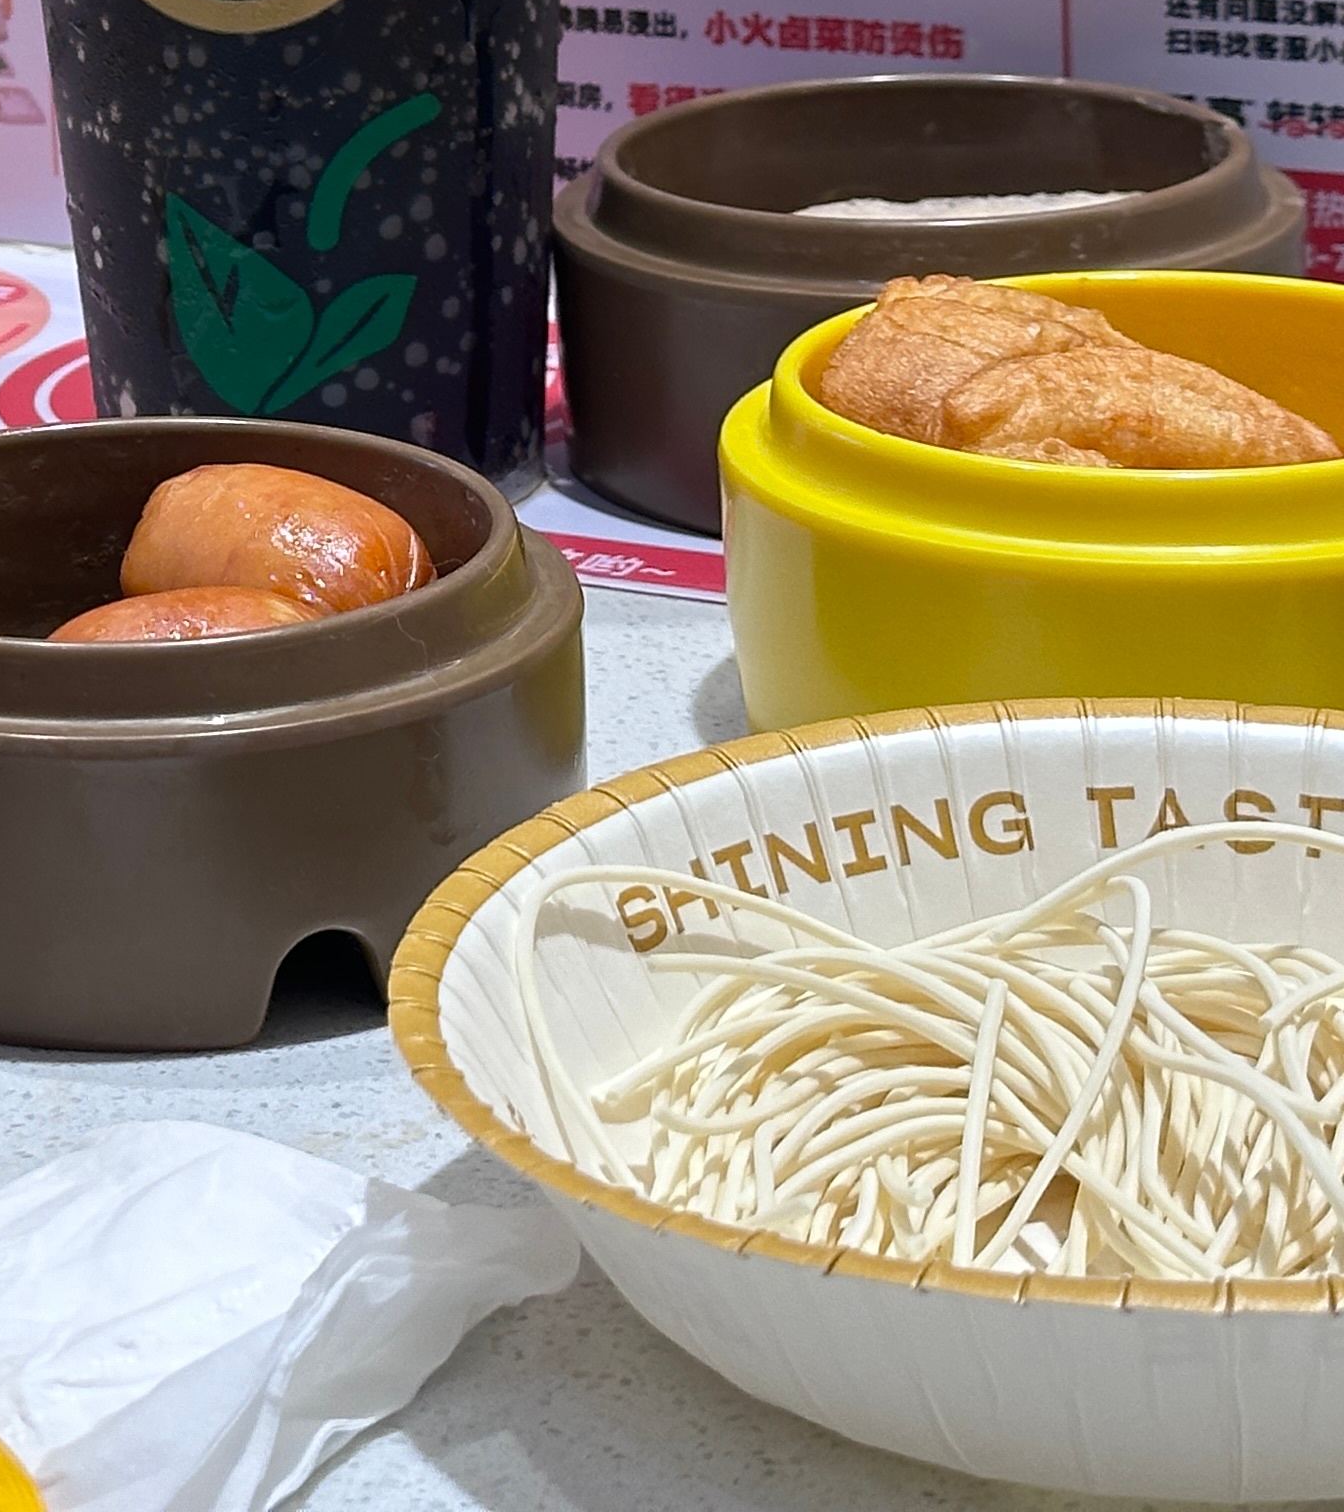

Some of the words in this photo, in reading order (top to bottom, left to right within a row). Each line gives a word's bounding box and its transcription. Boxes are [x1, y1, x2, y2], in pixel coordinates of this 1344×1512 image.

[1166, 28, 1344, 63] 扫码找客服小
[615, 789, 1035, 953] SHINING
